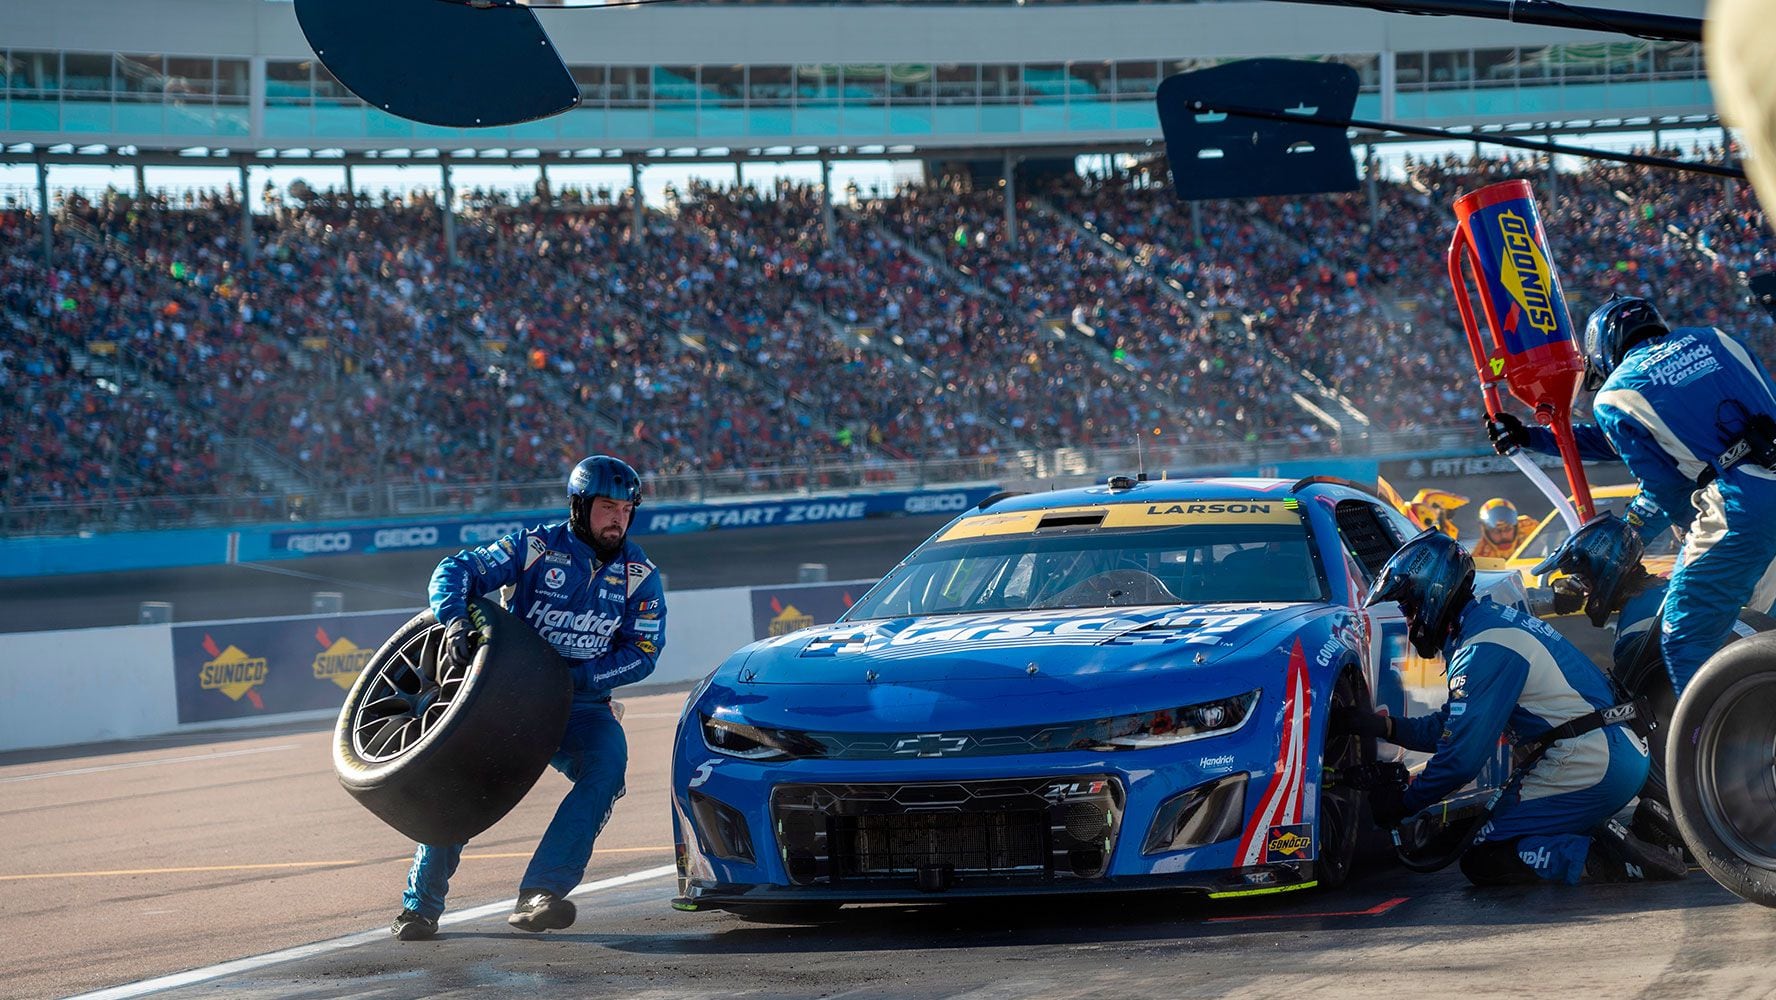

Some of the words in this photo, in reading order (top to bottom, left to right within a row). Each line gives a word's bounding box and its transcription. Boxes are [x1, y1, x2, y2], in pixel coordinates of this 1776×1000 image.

[1501, 217, 1554, 328] SUNOCO
[1489, 355, 1505, 376] 4
[1648, 343, 1712, 386] Hendrick
[1668, 355, 1718, 387] Cars.com
[904, 493, 966, 514] GEICO
[1147, 504, 1271, 515] LARSON
[650, 505, 781, 531] RESTART
[784, 501, 867, 522] ZONE
[374, 527, 438, 549] GEICO
[526, 600, 623, 637] Hendrick
[538, 625, 612, 649] Cars.com
[203, 661, 266, 687] SUNOCO
[688, 758, 725, 787] 5
[1200, 755, 1235, 768] Hendrick
[1044, 781, 1106, 797] ZL1
[1269, 838, 1309, 850] SUNOCO
